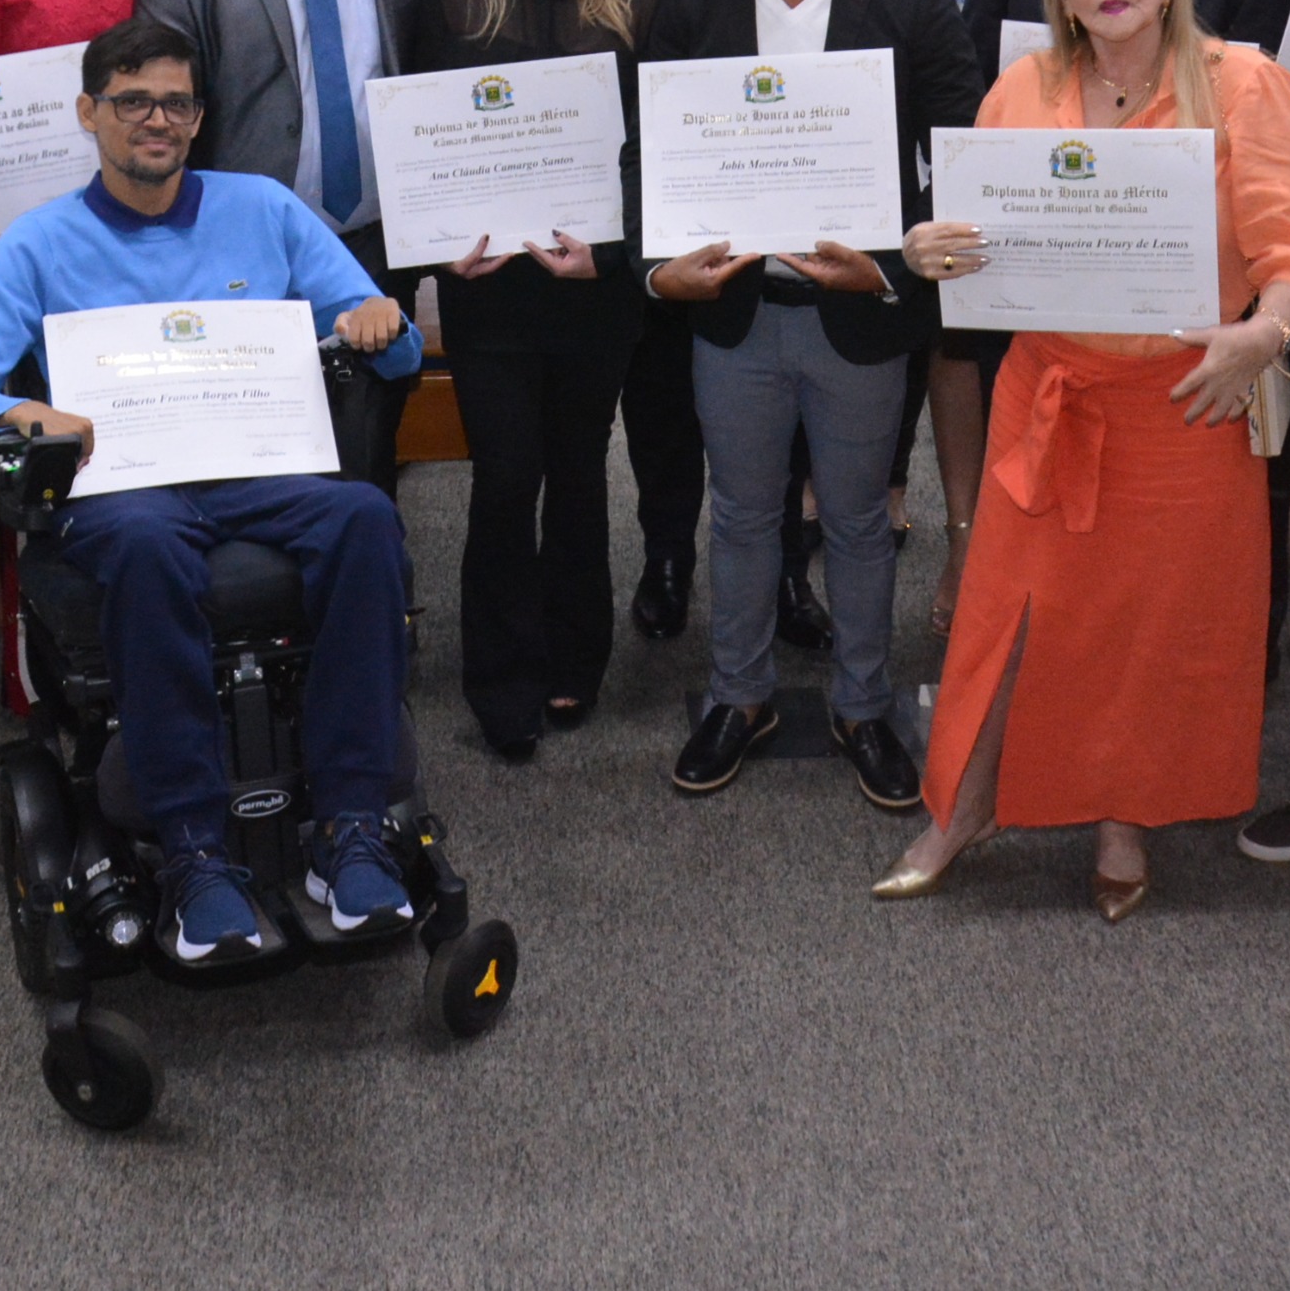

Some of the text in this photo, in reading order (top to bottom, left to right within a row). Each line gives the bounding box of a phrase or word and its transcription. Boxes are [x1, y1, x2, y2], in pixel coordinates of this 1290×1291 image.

[10, 108, 23, 118] ao
[25, 97, 64, 116] Mérito
[682, 104, 849, 125] Diploma de Honra ao Mérito
[5, 124, 14, 132] de
[16, 116, 49, 130] Goiânia
[413, 106, 579, 137] Diploma de Honra ao Mérito
[701, 126, 735, 137] Câmara
[785, 125, 794, 133] de
[797, 121, 832, 132] Goiânia
[432, 123, 562, 147] Câmara Municipal de Goiânia
[17, 151, 38, 164] Eloy
[40, 145, 69, 159] Braga
[747, 158, 788, 169] Moreira
[791, 156, 816, 166] Silva
[428, 154, 574, 181] Ana Cláudia Camargo Santos
[982, 185, 1167, 199] Diploma de Honra ao Mérito
[1001, 203, 1147, 214] Câmara Municipal de Goiânia
[1004, 238, 1042, 247] Fátima
[1046, 238, 1092, 249] Siqueira
[1096, 238, 1132, 249] Fleury
[1136, 238, 1148, 248] de
[1152, 239, 1188, 248] Lemos
[111, 396, 155, 408] Gilberto
[201, 389, 238, 402] Borges
[242, 388, 270, 398] Filho
[238, 794, 284, 813] permobil
[85, 857, 111, 881] M3
